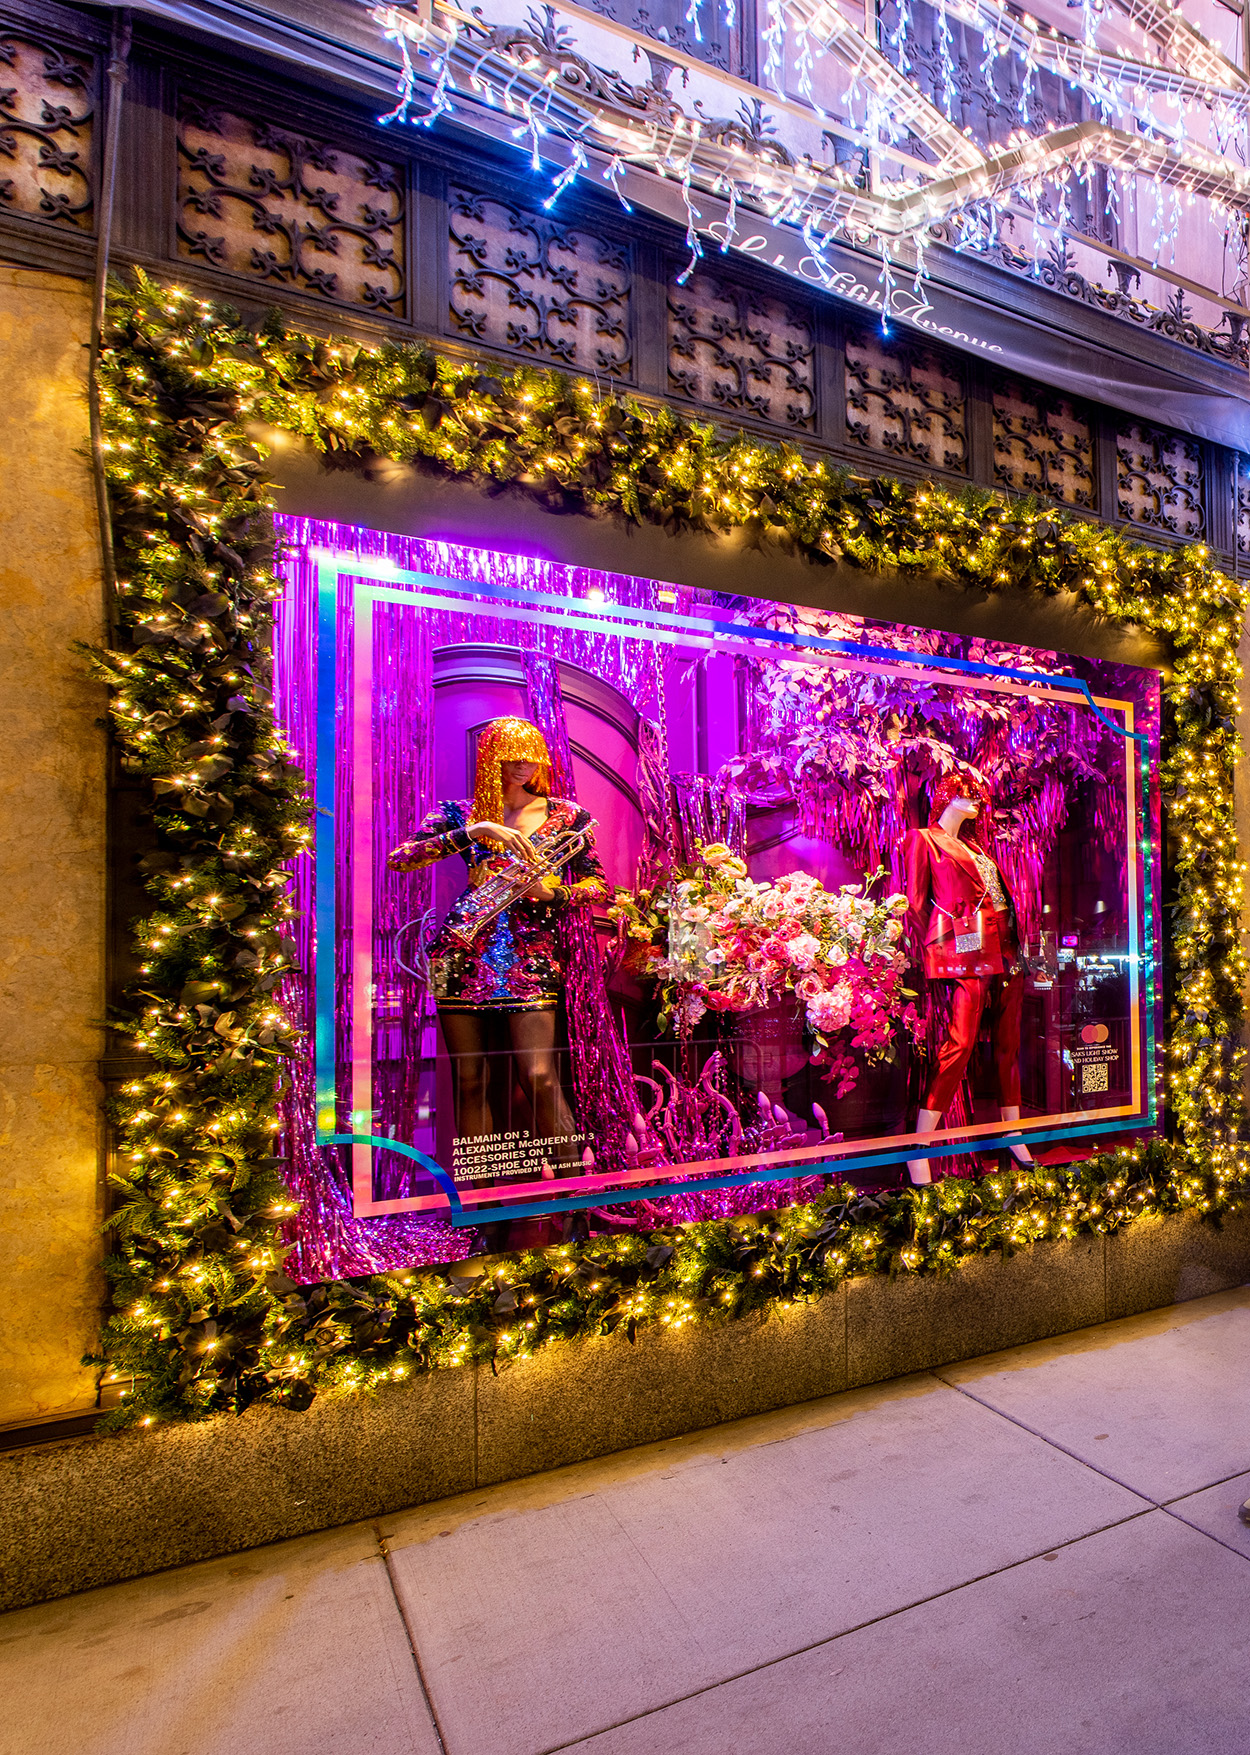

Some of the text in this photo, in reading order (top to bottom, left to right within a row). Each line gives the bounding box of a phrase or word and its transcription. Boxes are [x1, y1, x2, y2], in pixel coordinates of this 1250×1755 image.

[891, 290, 1004, 355] Avenue
[452, 1132, 595, 1156] ALEXANDER McQUEEN ON 3
[453, 1130, 530, 1146] BALMAIN ON 3
[452, 1147, 553, 1166] ACCESSORIES ON 1
[453, 1157, 548, 1176] 10022-SHOE ON 8
[454, 1171, 500, 1182] INSTRUMENTS
[501, 1167, 532, 1176] PROVIDED
[572, 1160, 592, 1168] MUSIC
